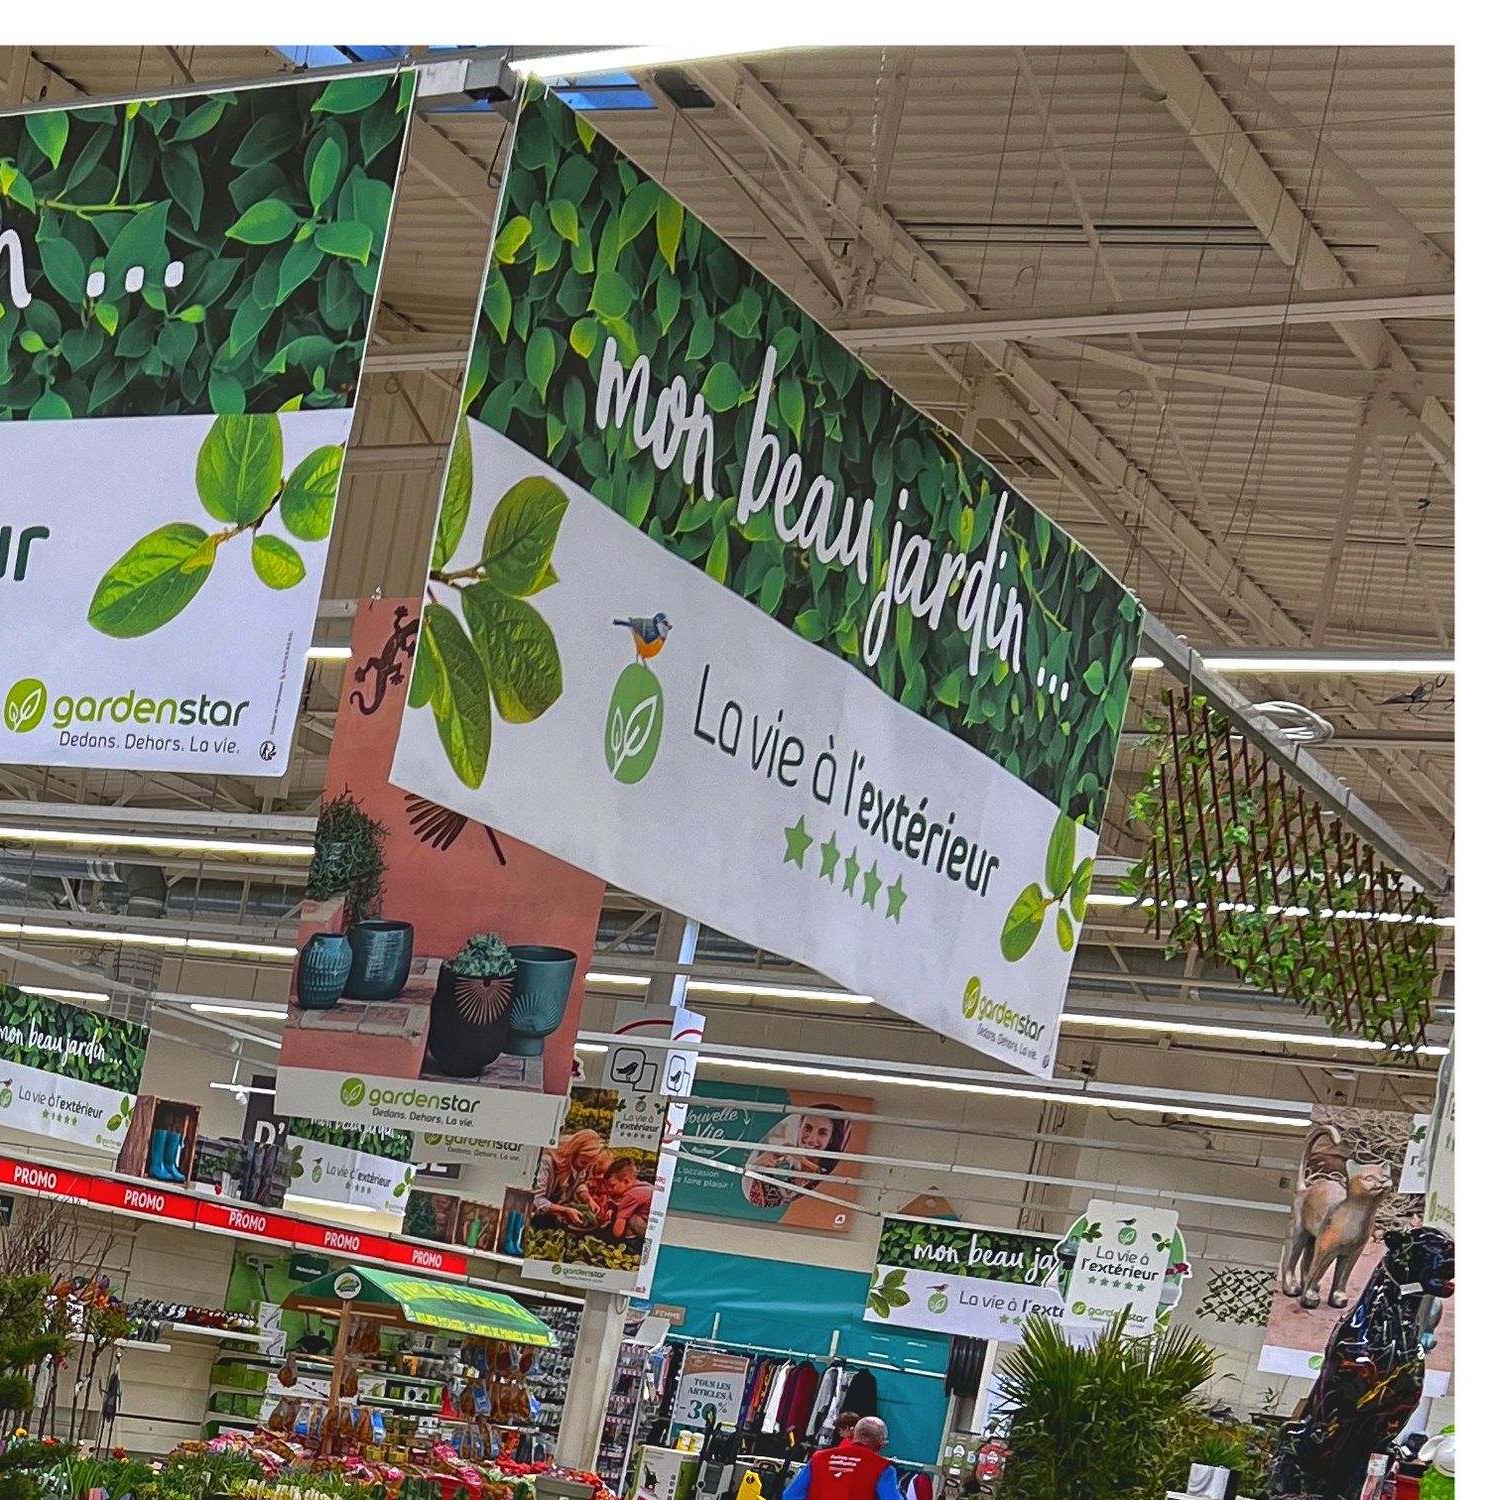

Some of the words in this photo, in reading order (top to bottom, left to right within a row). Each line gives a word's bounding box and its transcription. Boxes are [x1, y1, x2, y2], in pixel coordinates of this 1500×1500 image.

[595, 336, 714, 501] mon
[737, 345, 874, 585] beau
[863, 488, 1024, 677] jardin
[51, 689, 250, 729] gardenstar
[59, 731, 120, 749] Dedans.
[125, 733, 185, 752] Dehors.
[190, 736, 209, 753] La
[213, 738, 240, 754] vie.
[694, 663, 743, 757] La
[752, 709, 805, 787] vie
[812, 734, 837, 805] à
[844, 750, 1000, 897] l'extérieur
[978, 996, 1045, 1041] gardenstar
[28, 1017, 62, 1050] beau
[61, 1028, 105, 1066] jardin
[18, 1085, 30, 1100] La
[33, 1089, 44, 1105] vie
[368, 1086, 480, 1113] gardenstar
[446, 1116, 457, 1126] La
[459, 1117, 474, 1128] vie.
[13, 1166, 57, 1190] PROMO
[124, 1190, 165, 1212] PROMO
[228, 1210, 266, 1232] PROMO
[324, 1231, 360, 1251] PROMO
[412, 1250, 442, 1268] PROMO
[914, 1243, 959, 1265] mon
[967, 1234, 1025, 1270] beau
[1024, 1247, 1055, 1283] ja
[1096, 1245, 1113, 1260] La
[1117, 1247, 1137, 1263] vie
[1139, 1249, 1150, 1265] à
[1081, 1257, 1159, 1282] l'extérieur
[959, 1290, 979, 1308] La
[982, 1293, 1005, 1310] vie
[1008, 1296, 1017, 1311] à
[716, 1382, 731, 1391] LES
